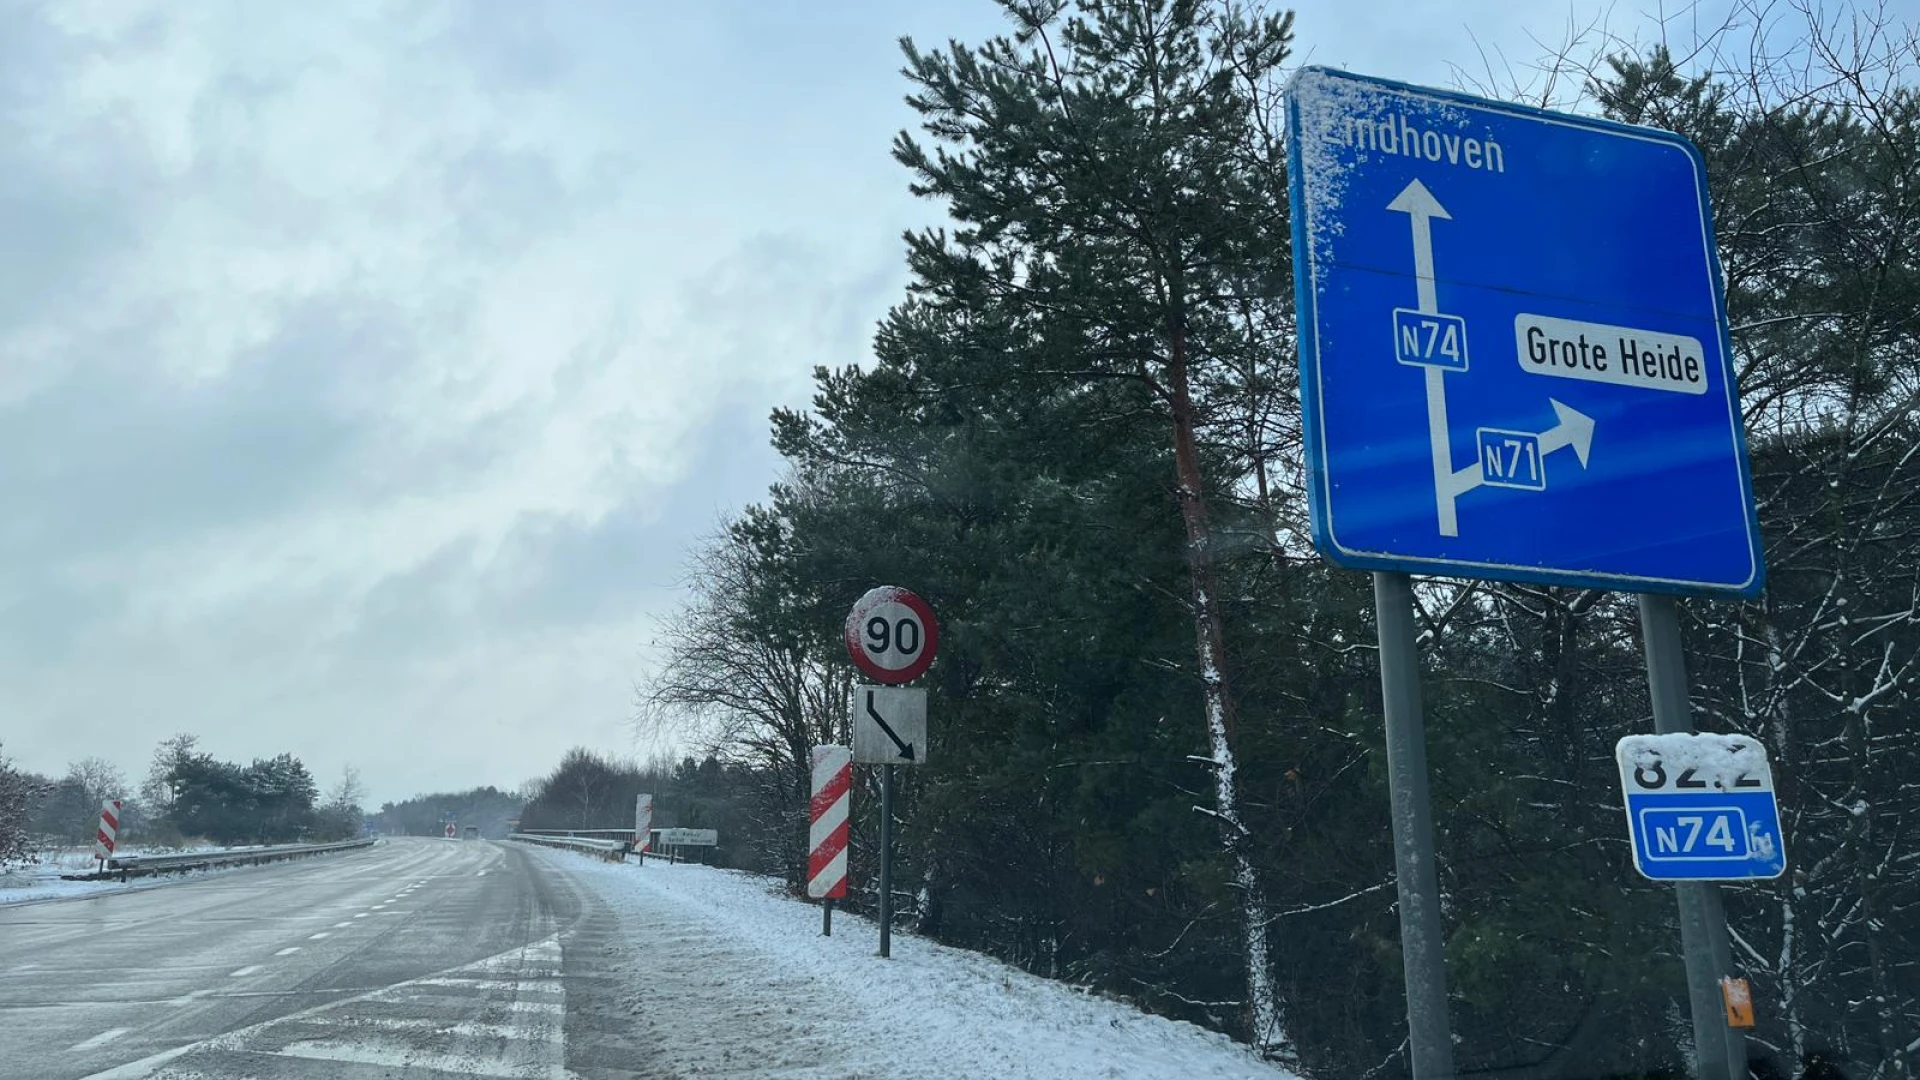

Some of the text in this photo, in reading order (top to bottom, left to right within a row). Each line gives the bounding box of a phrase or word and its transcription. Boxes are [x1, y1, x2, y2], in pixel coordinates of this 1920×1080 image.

[1402, 320, 1459, 362] N74
[1527, 326, 1700, 383] Grote Heide
[1486, 440, 1537, 481] N71
[867, 616, 919, 655] 90
[1655, 815, 1735, 853] N74
